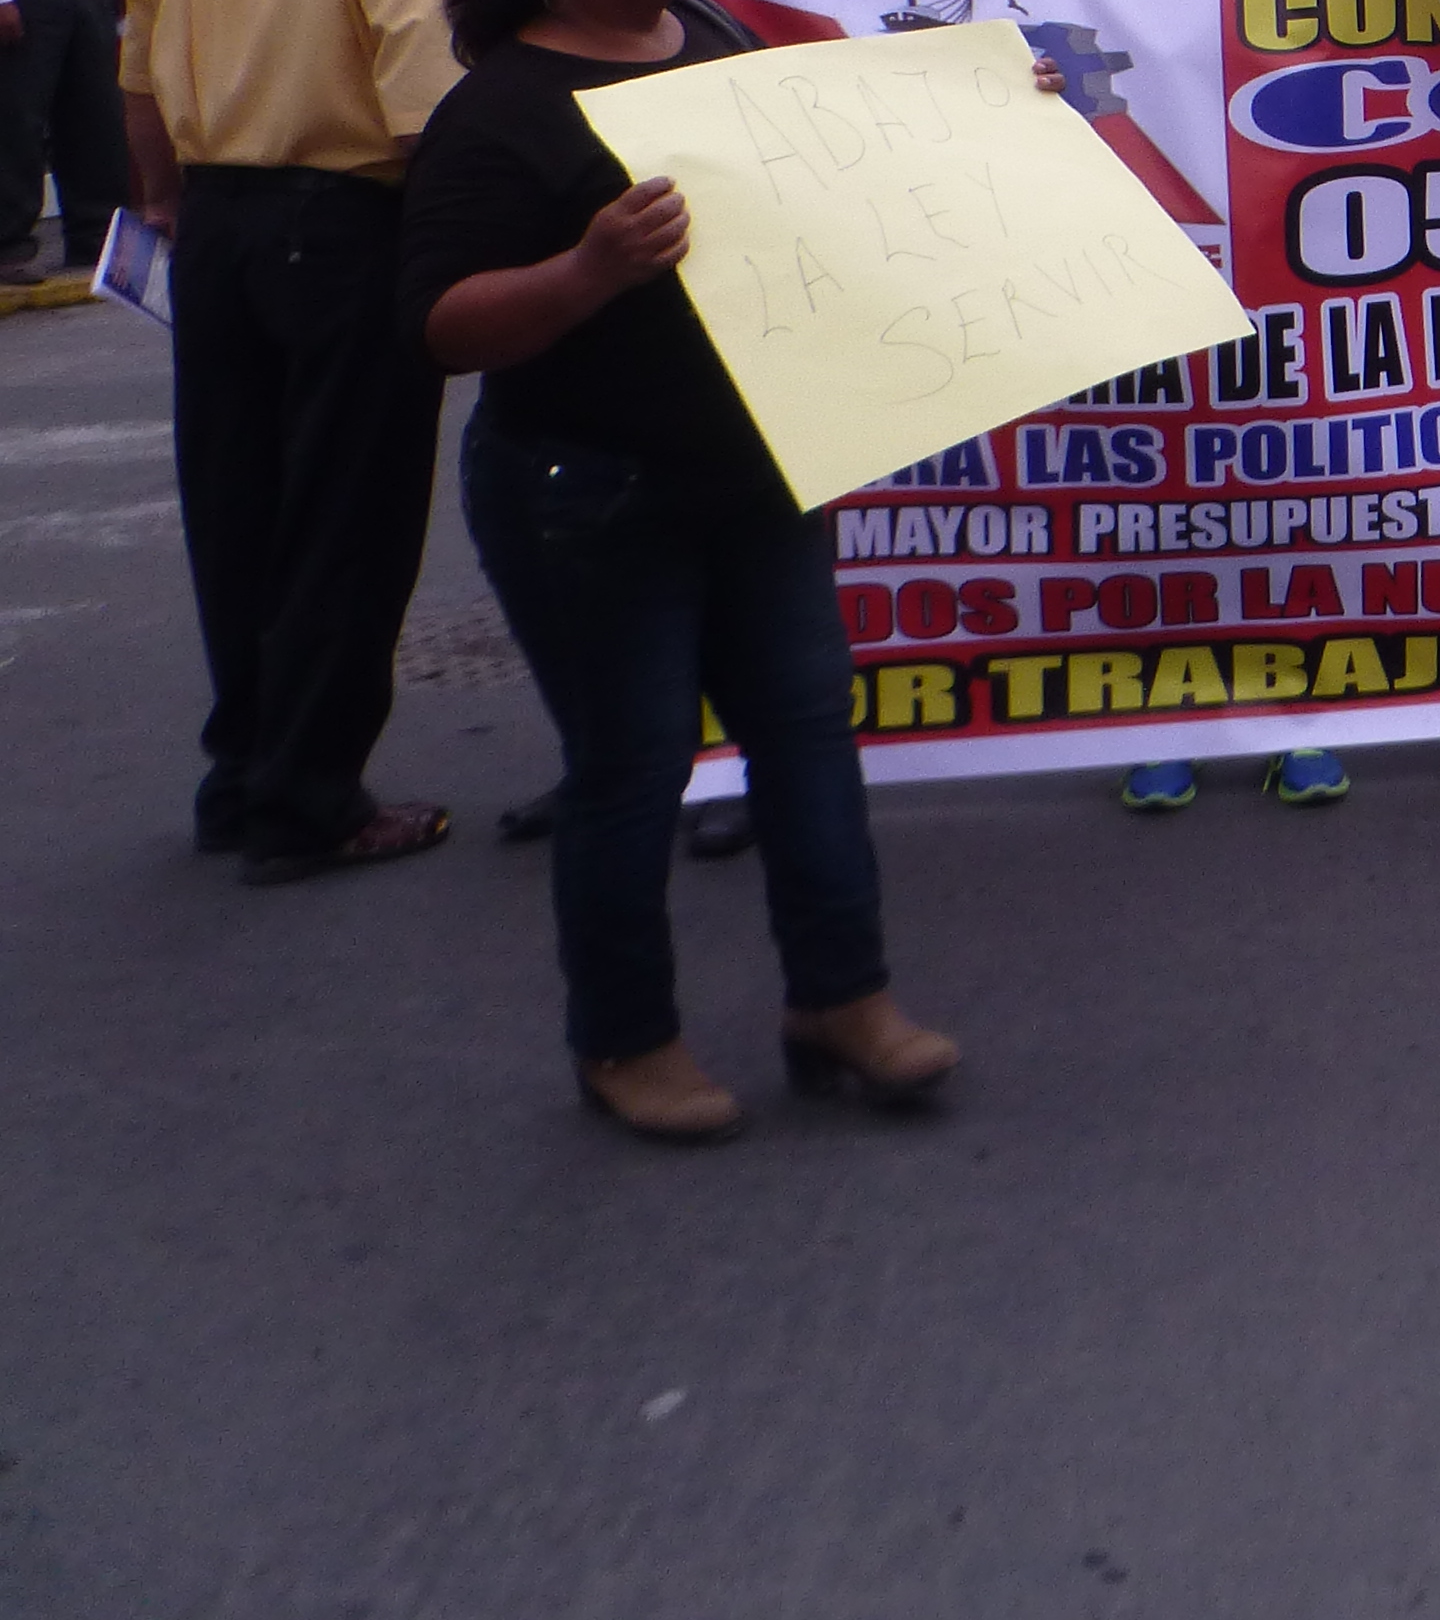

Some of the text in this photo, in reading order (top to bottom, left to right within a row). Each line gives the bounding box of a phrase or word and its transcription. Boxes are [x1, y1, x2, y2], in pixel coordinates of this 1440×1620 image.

[728, 67, 1010, 205] ABAJO
[745, 162, 1009, 338] LA LEY
[870, 234, 1184, 405] SERVIR
[1214, 311, 1301, 405] DE
[1328, 301, 1406, 394] LA
[1024, 427, 1159, 487] LAS
[836, 505, 1049, 560] MAYOR
[1040, 571, 1220, 632] POR
[1240, 563, 1344, 620] LA
